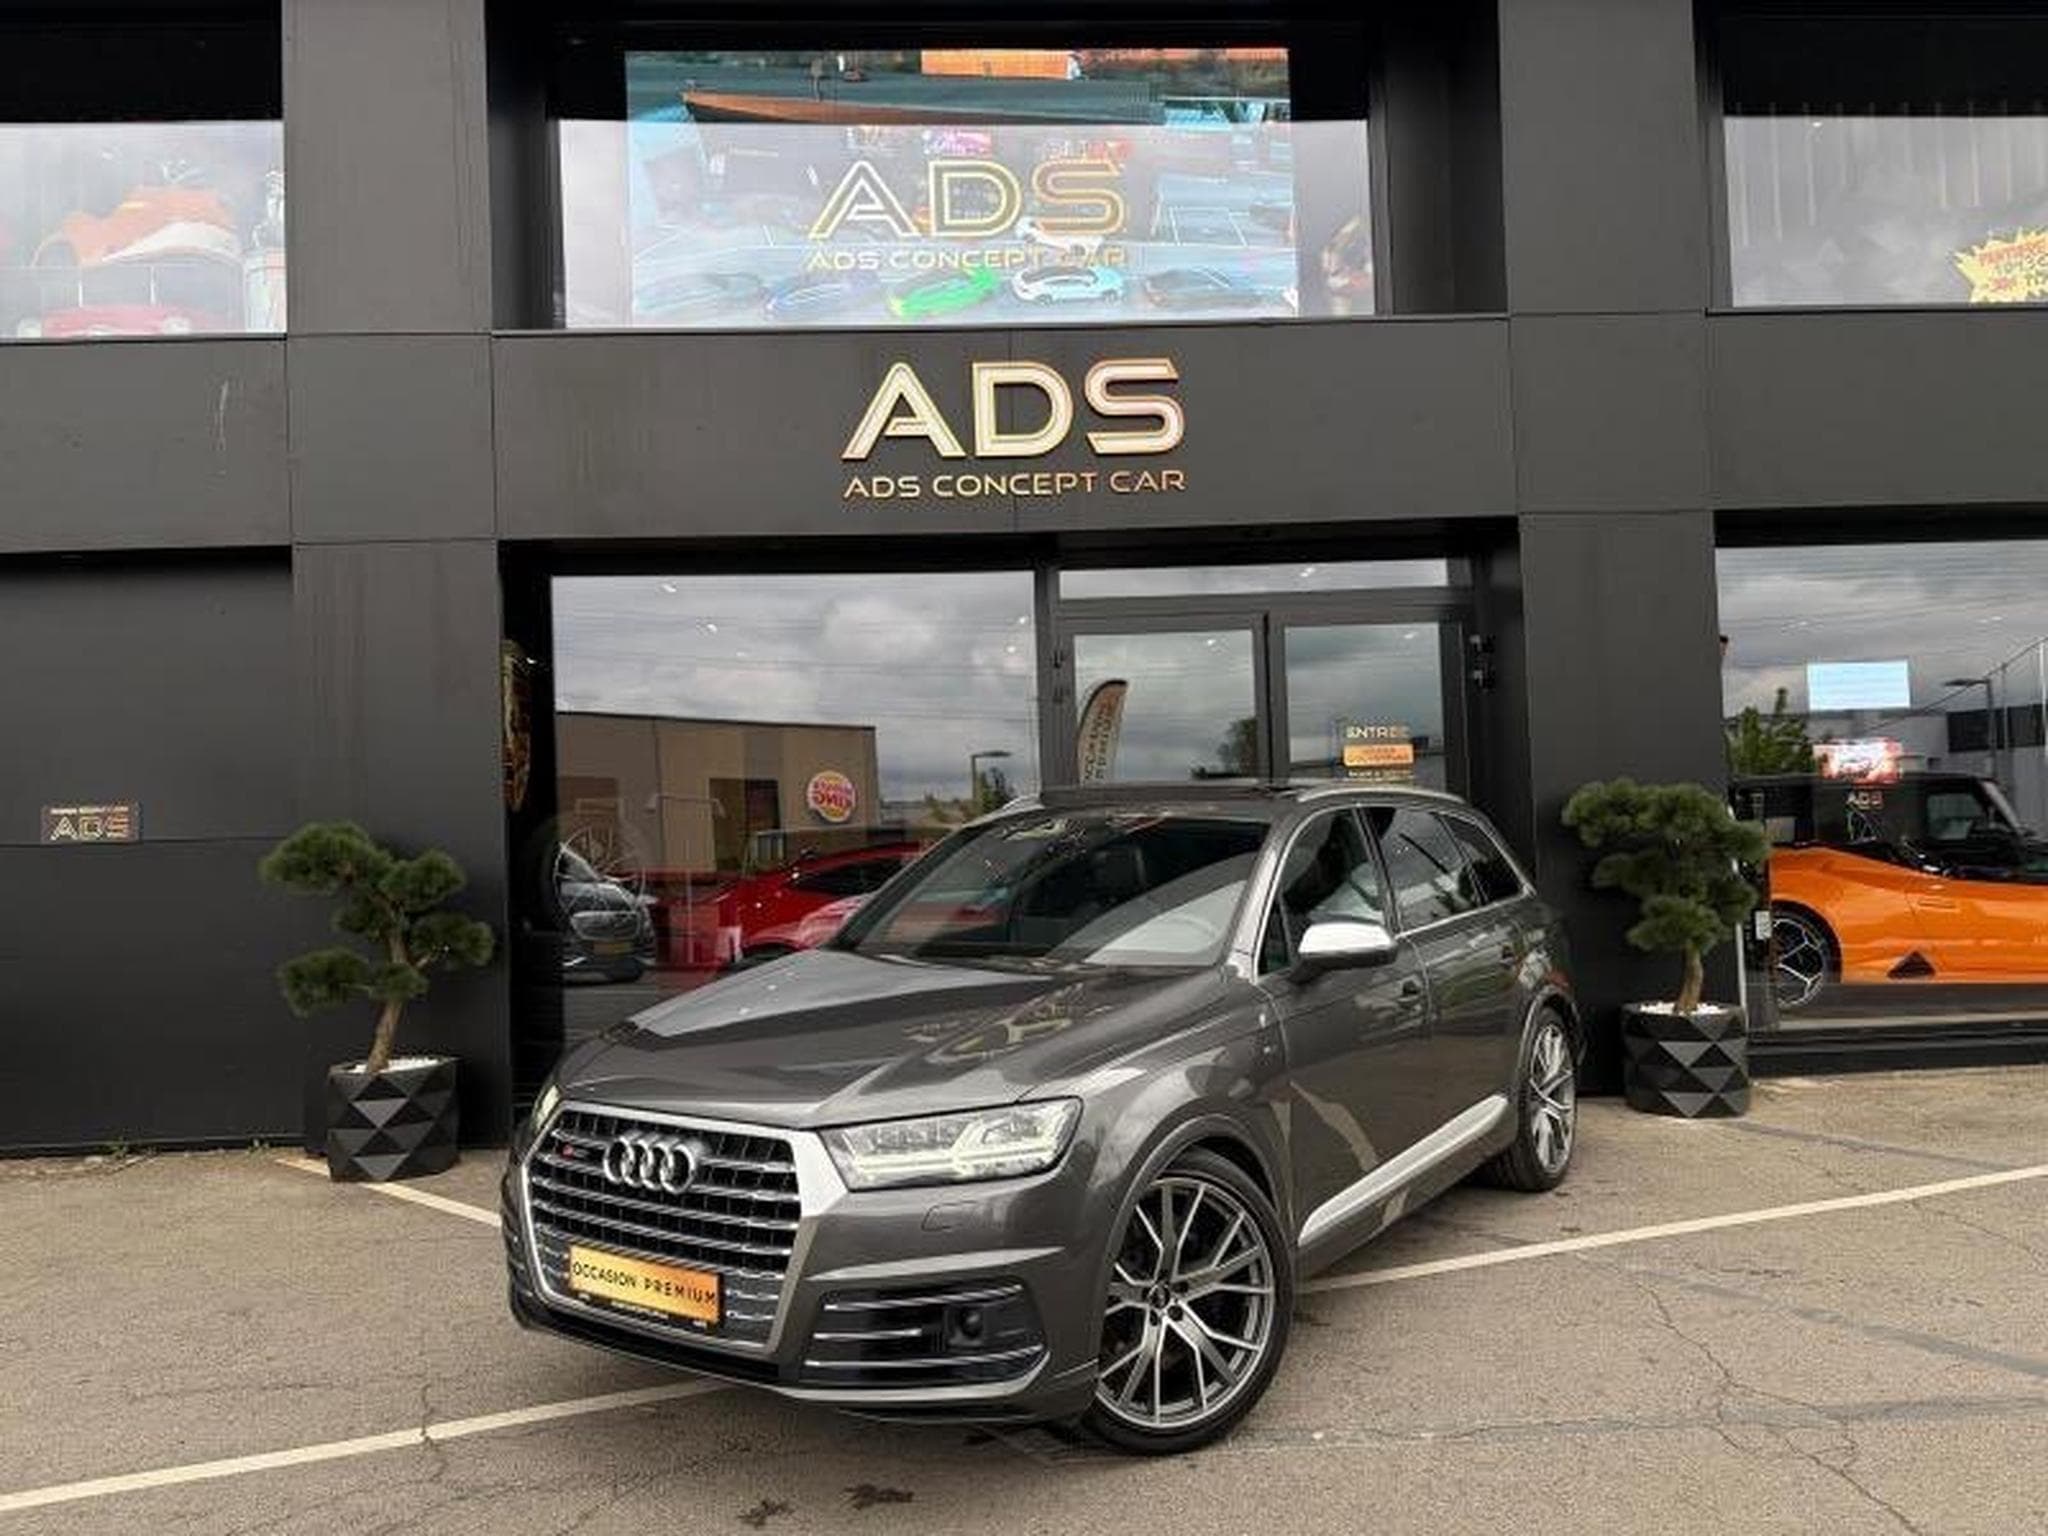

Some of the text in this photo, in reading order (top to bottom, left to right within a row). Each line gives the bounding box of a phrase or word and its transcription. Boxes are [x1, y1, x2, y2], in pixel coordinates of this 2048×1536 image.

[807, 159, 1126, 240] ADS
[807, 249, 880, 272] ADS
[889, 248, 1043, 270] CONCEPT
[841, 357, 1185, 461] ADS
[844, 469, 1186, 499] ADS CONCEPT CAR
[572, 1261, 716, 1306] OCCASION PREMIUM
